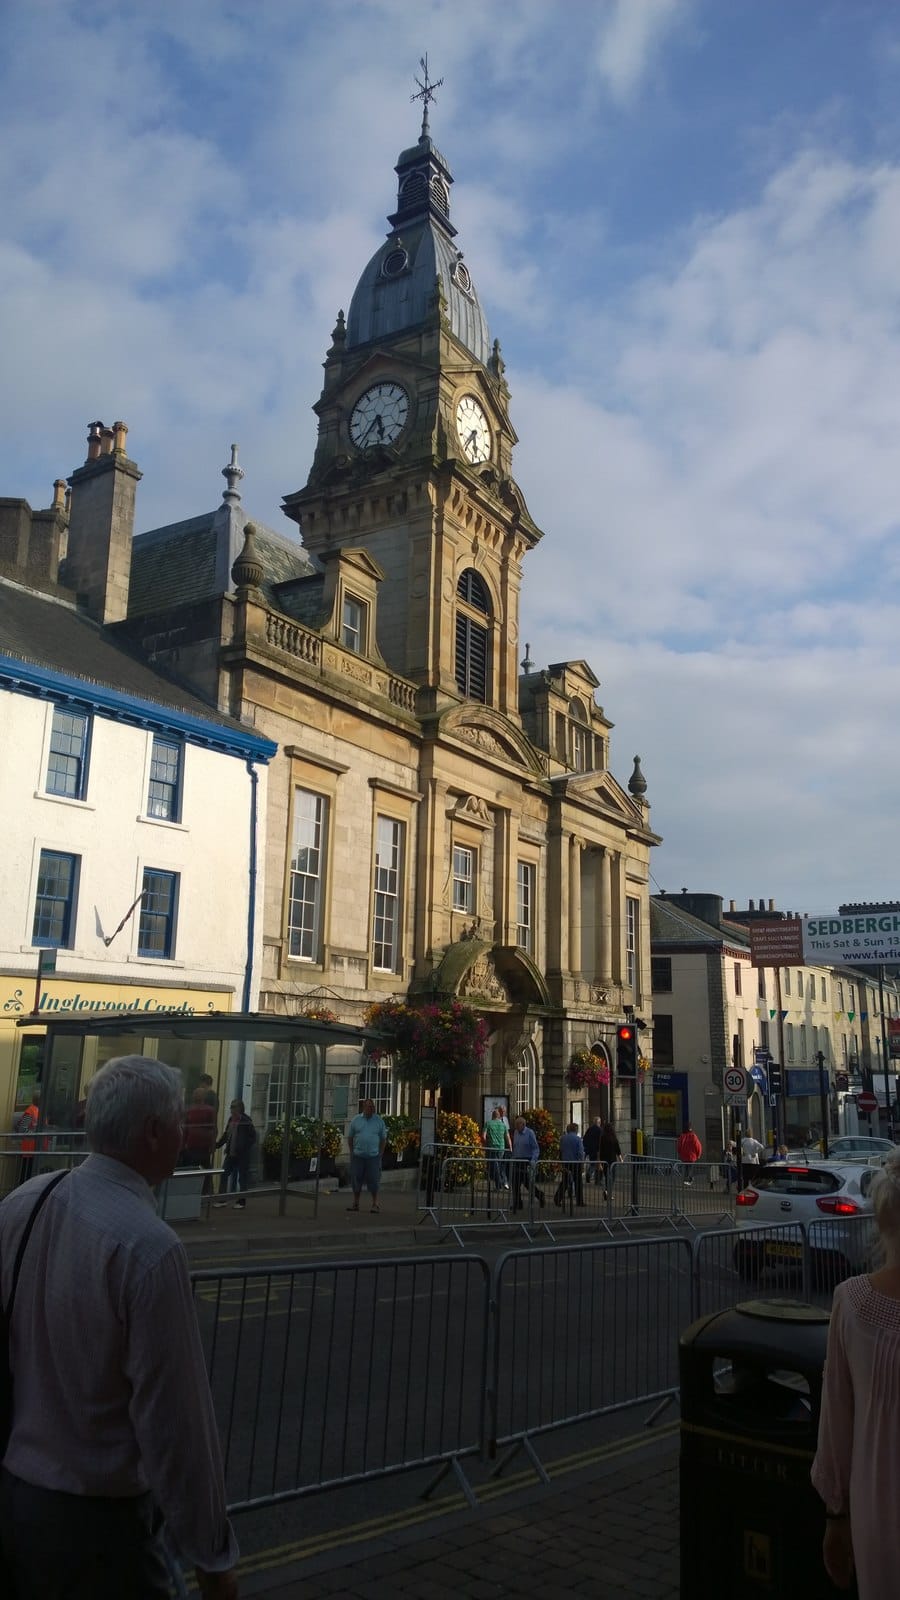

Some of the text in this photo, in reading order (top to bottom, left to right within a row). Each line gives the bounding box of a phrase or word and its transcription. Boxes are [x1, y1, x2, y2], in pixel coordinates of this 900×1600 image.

[807, 916, 900, 936] SEDBERGH
[811, 940, 831, 950] This
[833, 939, 850, 949] Sat
[853, 938, 861, 947] &
[864, 938, 884, 947] Sun
[39, 992, 141, 1011] Inglewood
[727, 1075, 742, 1086] 30
